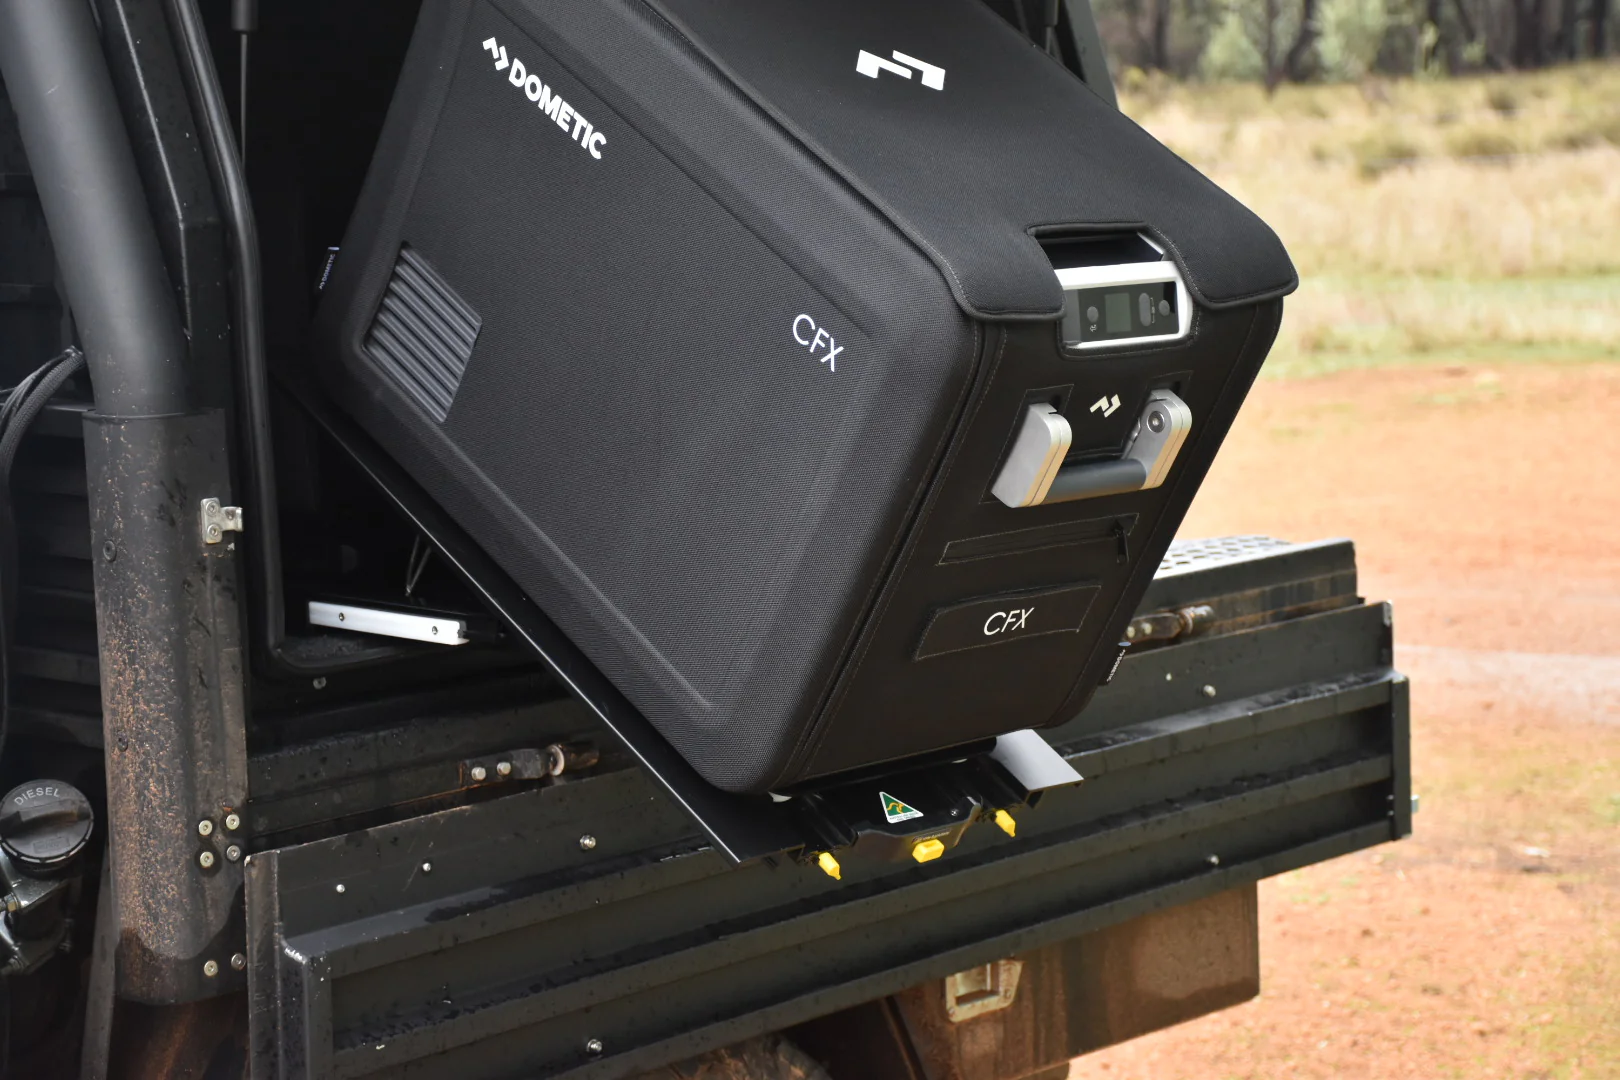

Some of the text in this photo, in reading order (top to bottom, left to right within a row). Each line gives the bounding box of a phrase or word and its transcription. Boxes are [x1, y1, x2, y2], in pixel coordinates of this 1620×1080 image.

[508, 57, 607, 160] DOMETIC
[792, 313, 845, 373] CFX
[983, 606, 1036, 636] CFX
[14, 786, 61, 806] DIESEL
